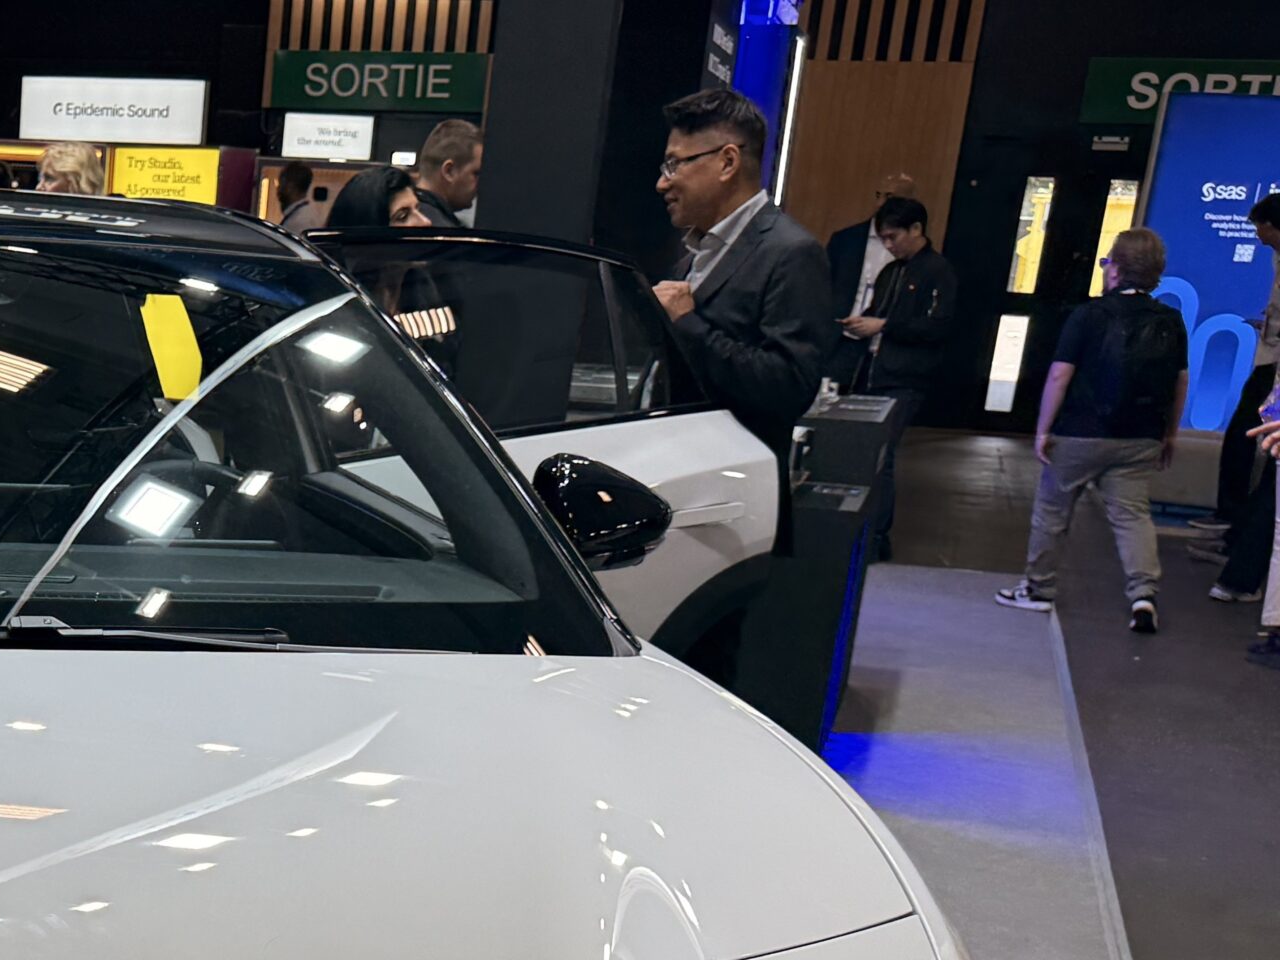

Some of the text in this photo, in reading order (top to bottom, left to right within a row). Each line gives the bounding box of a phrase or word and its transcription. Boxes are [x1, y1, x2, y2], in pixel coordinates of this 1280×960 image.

[304, 62, 452, 98] SORTIE
[66, 102, 170, 119] Epidemic Sound
[127, 156, 146, 171] Try
[1215, 185, 1247, 200] sas
